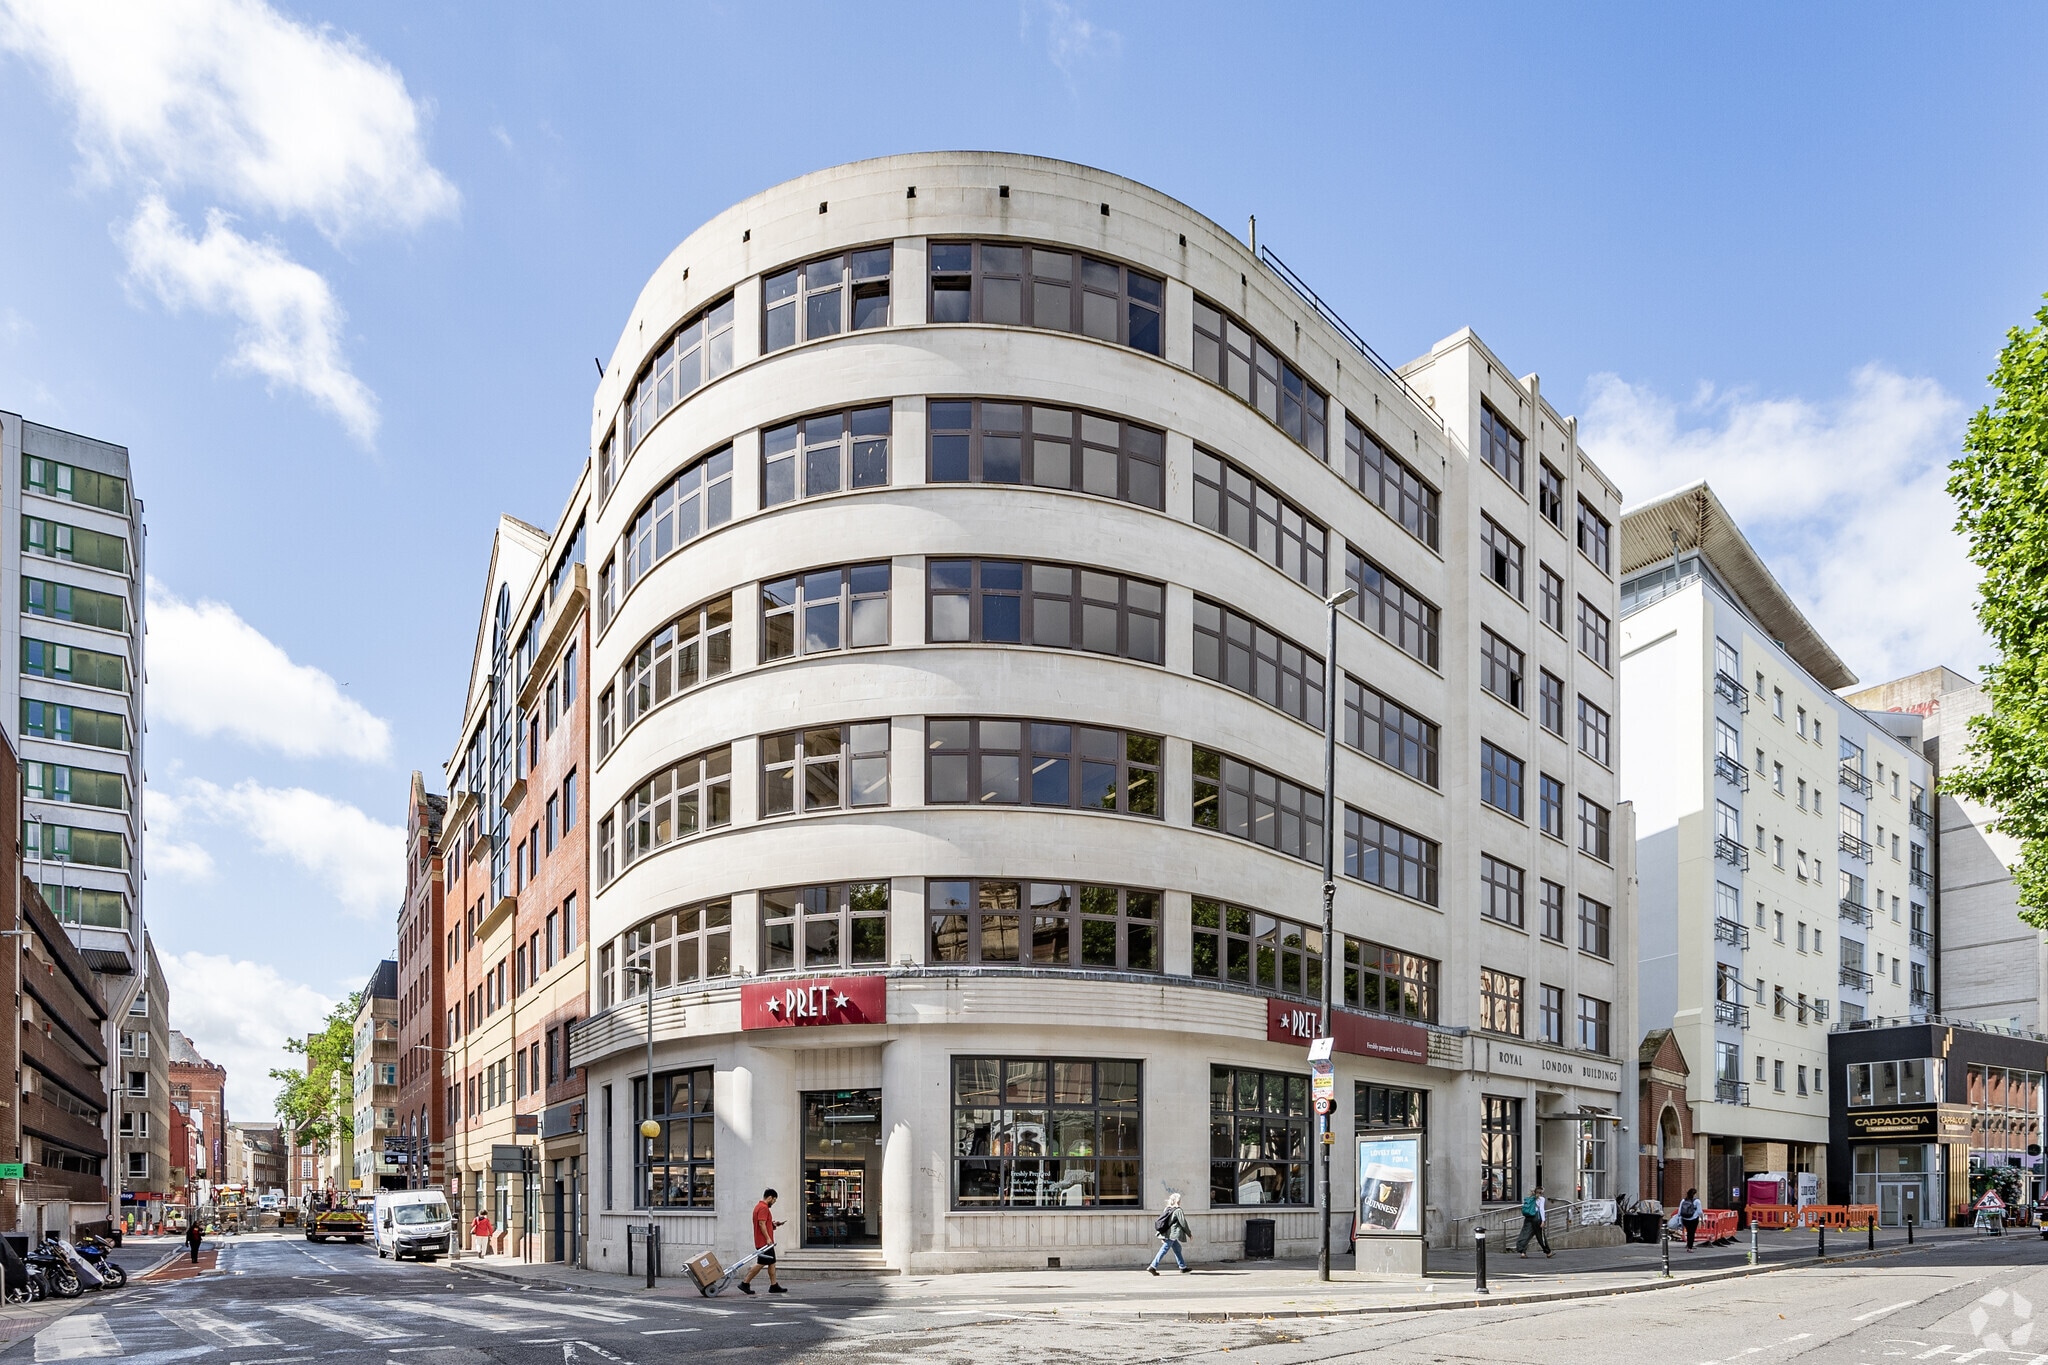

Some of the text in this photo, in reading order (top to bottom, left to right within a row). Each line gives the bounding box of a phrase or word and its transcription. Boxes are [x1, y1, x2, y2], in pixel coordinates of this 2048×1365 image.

[786, 986, 830, 1018] PRET
[1291, 1009, 1317, 1038] PRET
[1499, 1052, 1617, 1081] ROYAL LONDON BUILDINGS
[1317, 1101, 1327, 1109] 20
[1855, 1116, 1929, 1127] CAPPADOCIA
[1940, 1115, 1970, 1125] CAPPADOCIA
[1364, 1197, 1399, 1215] GUINNESS
